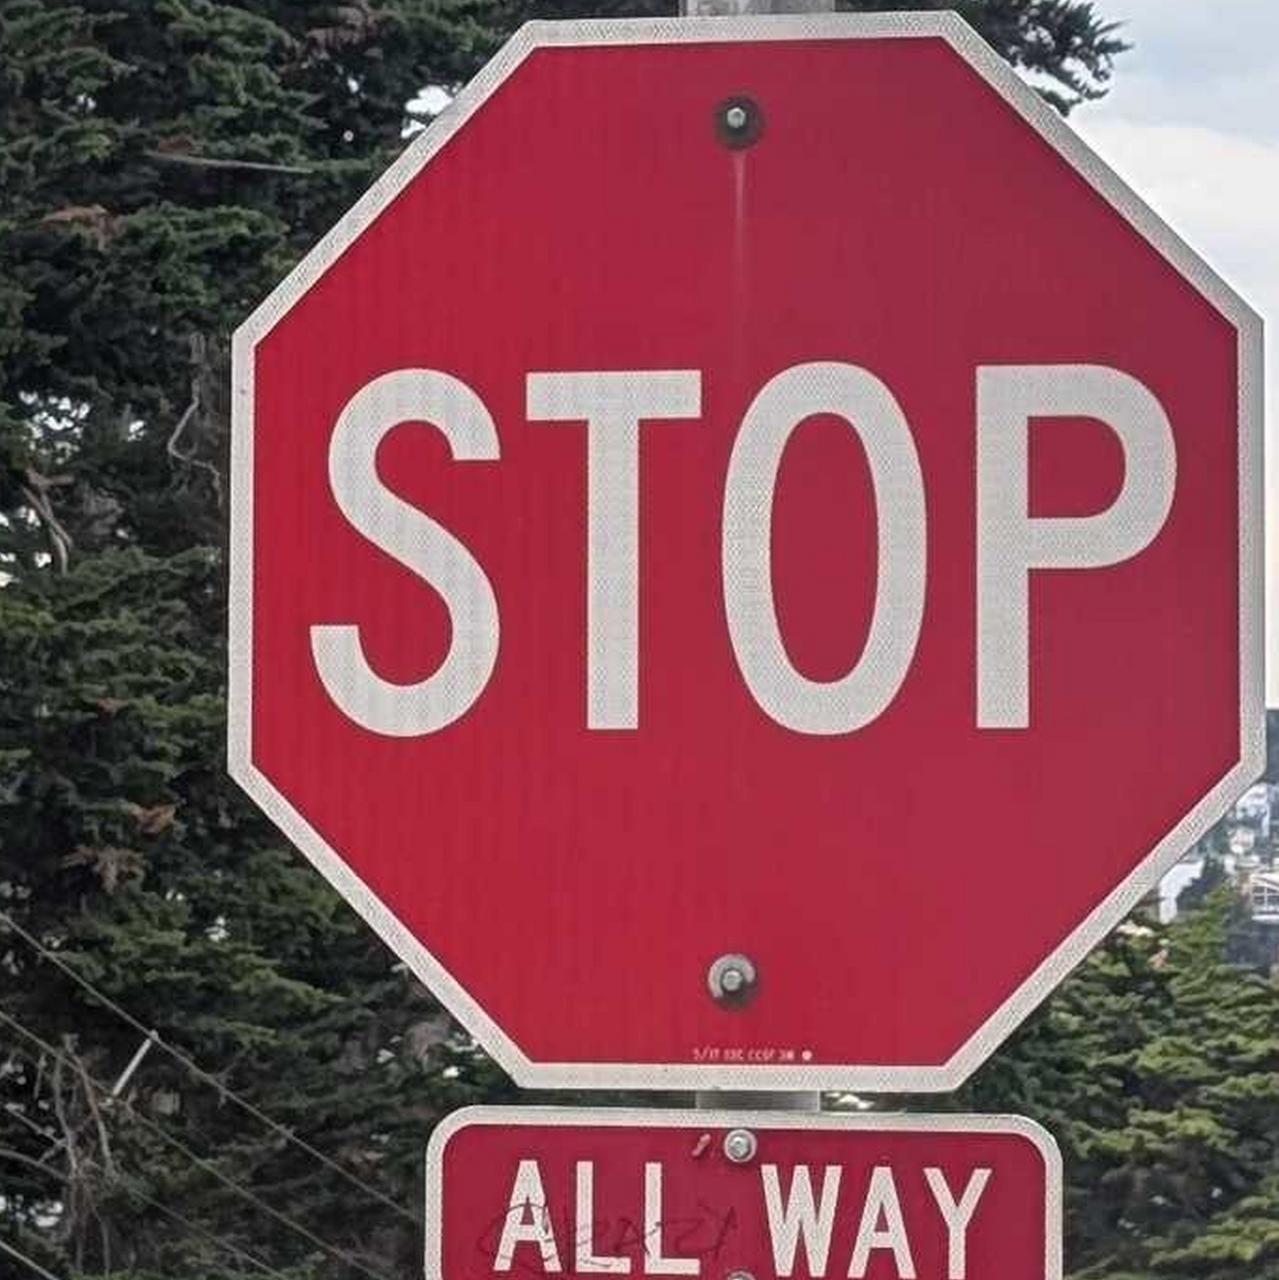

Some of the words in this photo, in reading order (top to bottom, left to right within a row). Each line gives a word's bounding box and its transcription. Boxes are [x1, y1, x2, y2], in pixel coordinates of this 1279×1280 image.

[309, 360, 1177, 738] STOP
[494, 1160, 701, 1275] ALL
[760, 1163, 992, 1280] WAY
